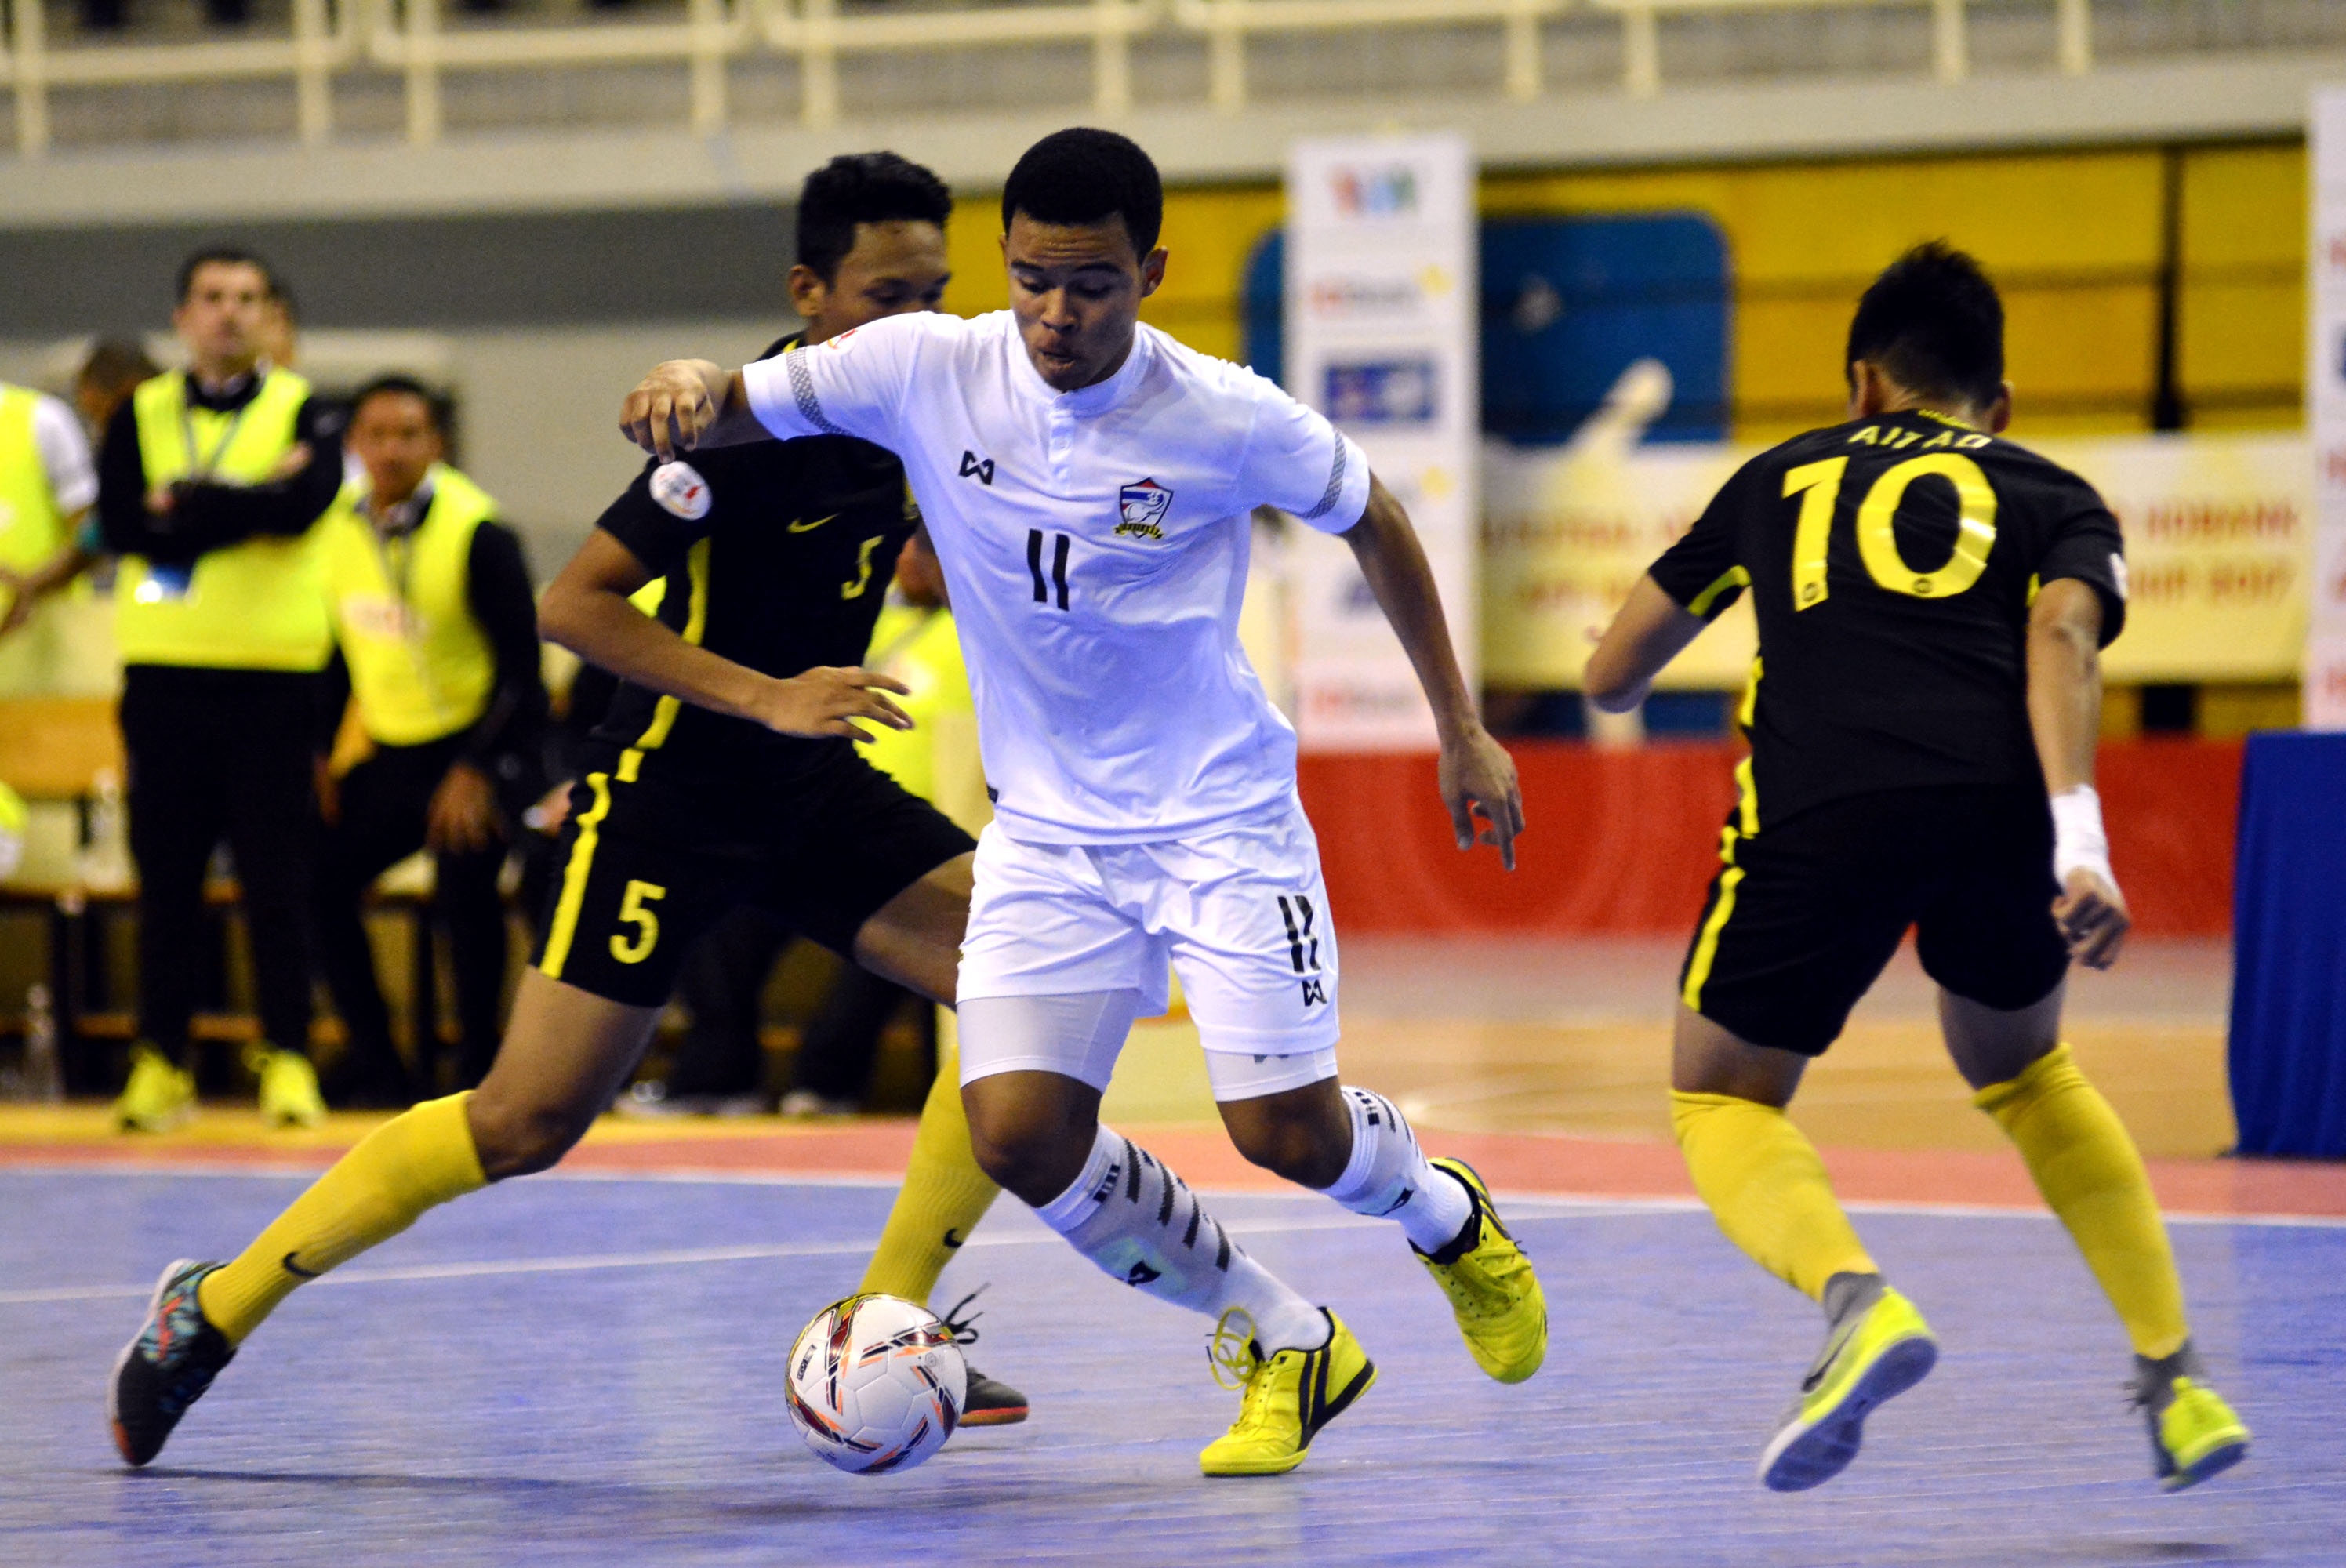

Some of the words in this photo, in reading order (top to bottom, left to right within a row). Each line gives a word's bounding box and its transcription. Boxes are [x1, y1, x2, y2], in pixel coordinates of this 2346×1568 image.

[1027, 528, 1070, 612] 11
[1781, 452, 1998, 612] 10
[609, 880, 667, 964] 5
[1277, 895, 1321, 974] 11
